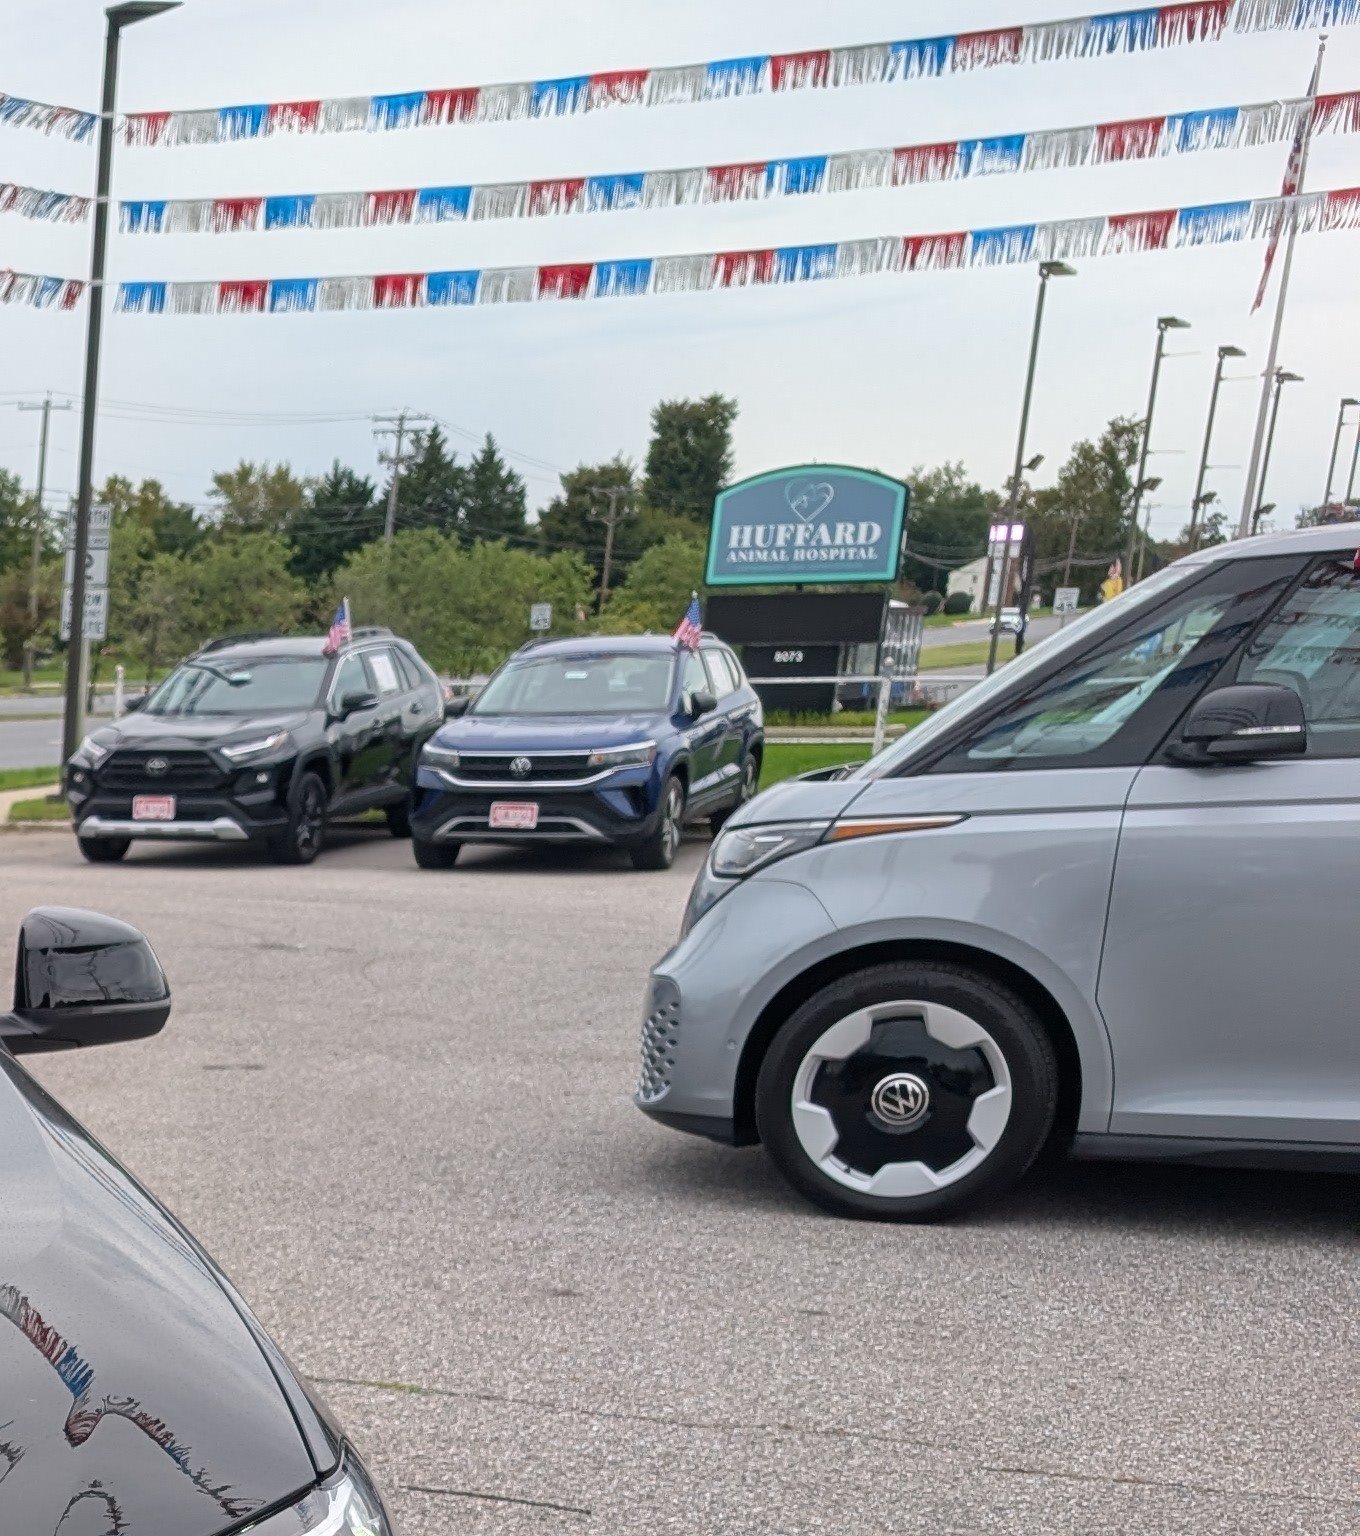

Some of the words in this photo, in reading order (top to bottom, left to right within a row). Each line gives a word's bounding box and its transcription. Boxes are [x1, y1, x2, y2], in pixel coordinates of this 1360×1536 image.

[728, 521, 882, 549] HUFFARD
[727, 549, 789, 563] ANIMAL
[793, 547, 878, 561] HOSPITAL
